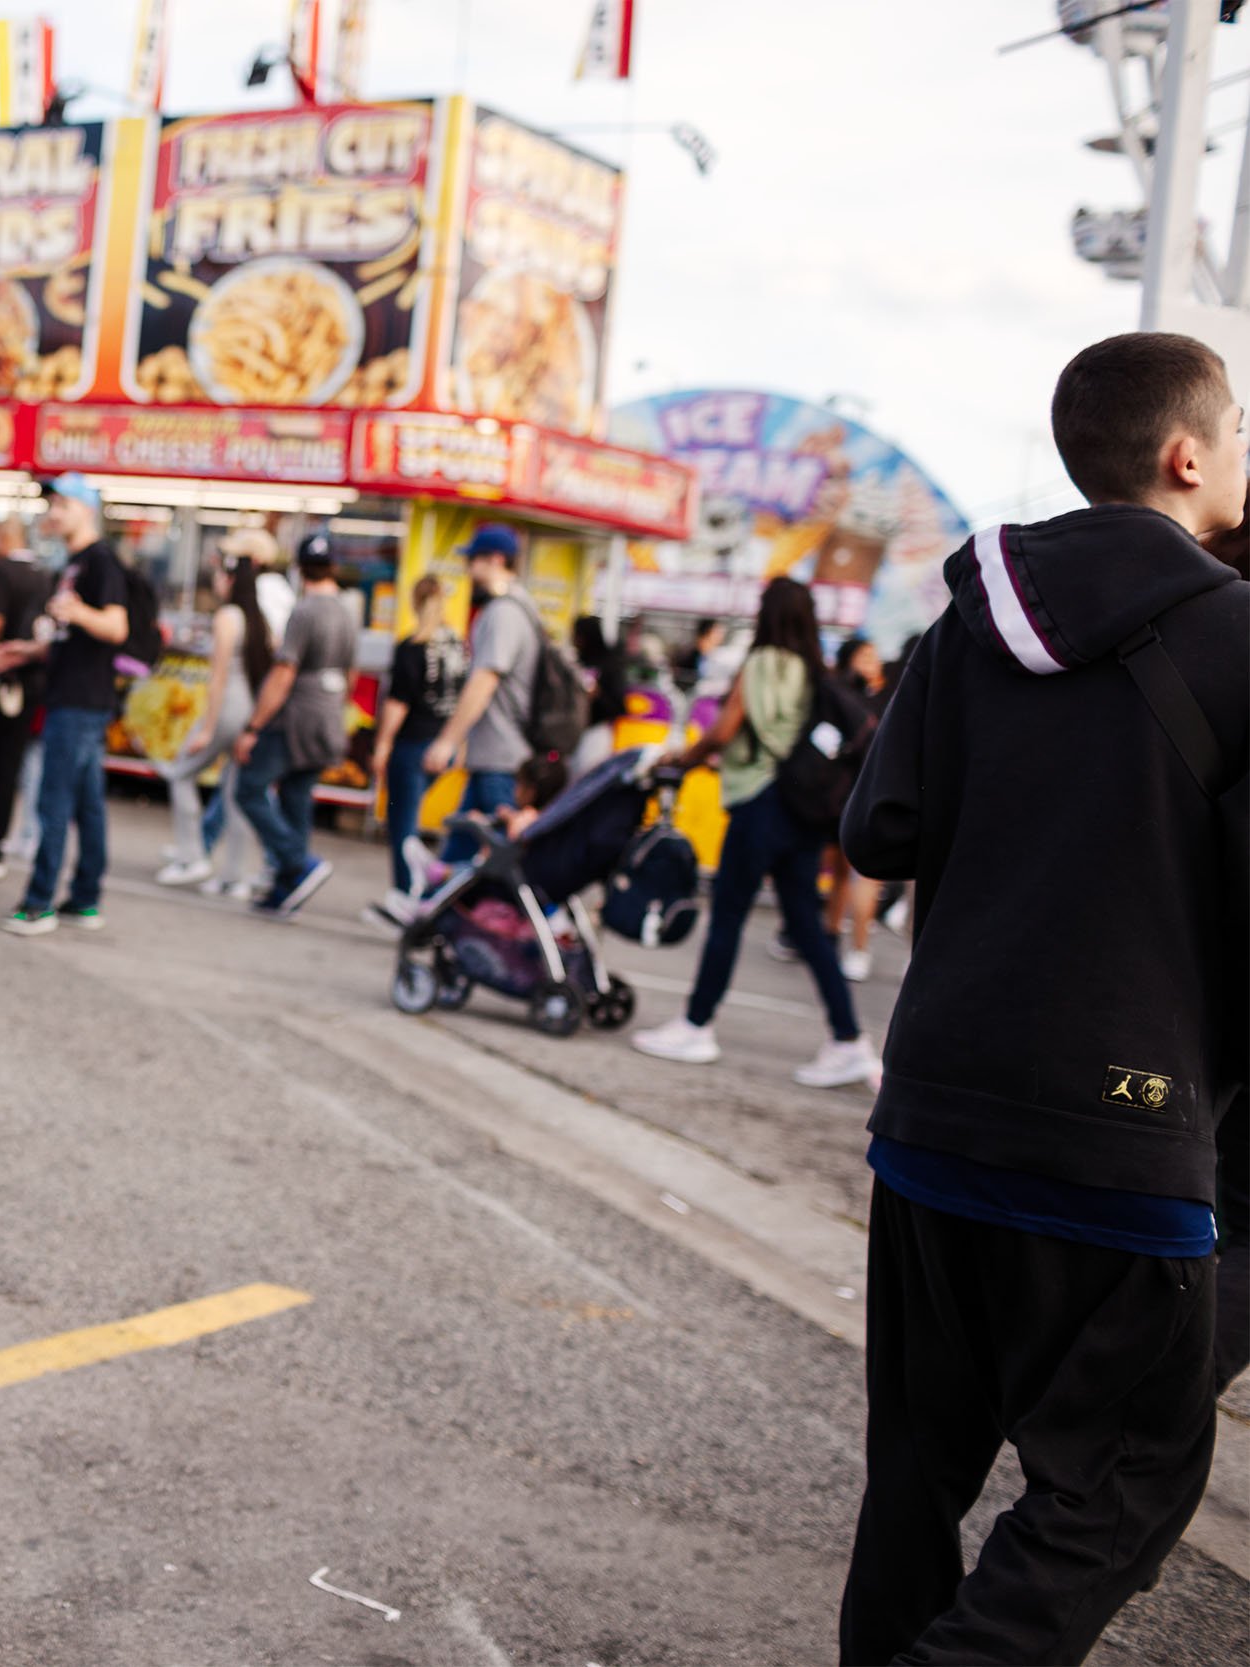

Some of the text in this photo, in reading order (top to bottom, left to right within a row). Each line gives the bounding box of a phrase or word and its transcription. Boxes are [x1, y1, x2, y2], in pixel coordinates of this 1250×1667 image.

[329, 113, 422, 175] CUT
[174, 186, 414, 261] FRIES
[114, 431, 214, 469] CHEESE
[665, 397, 758, 447] ICE
[697, 448, 823, 514] EAM
